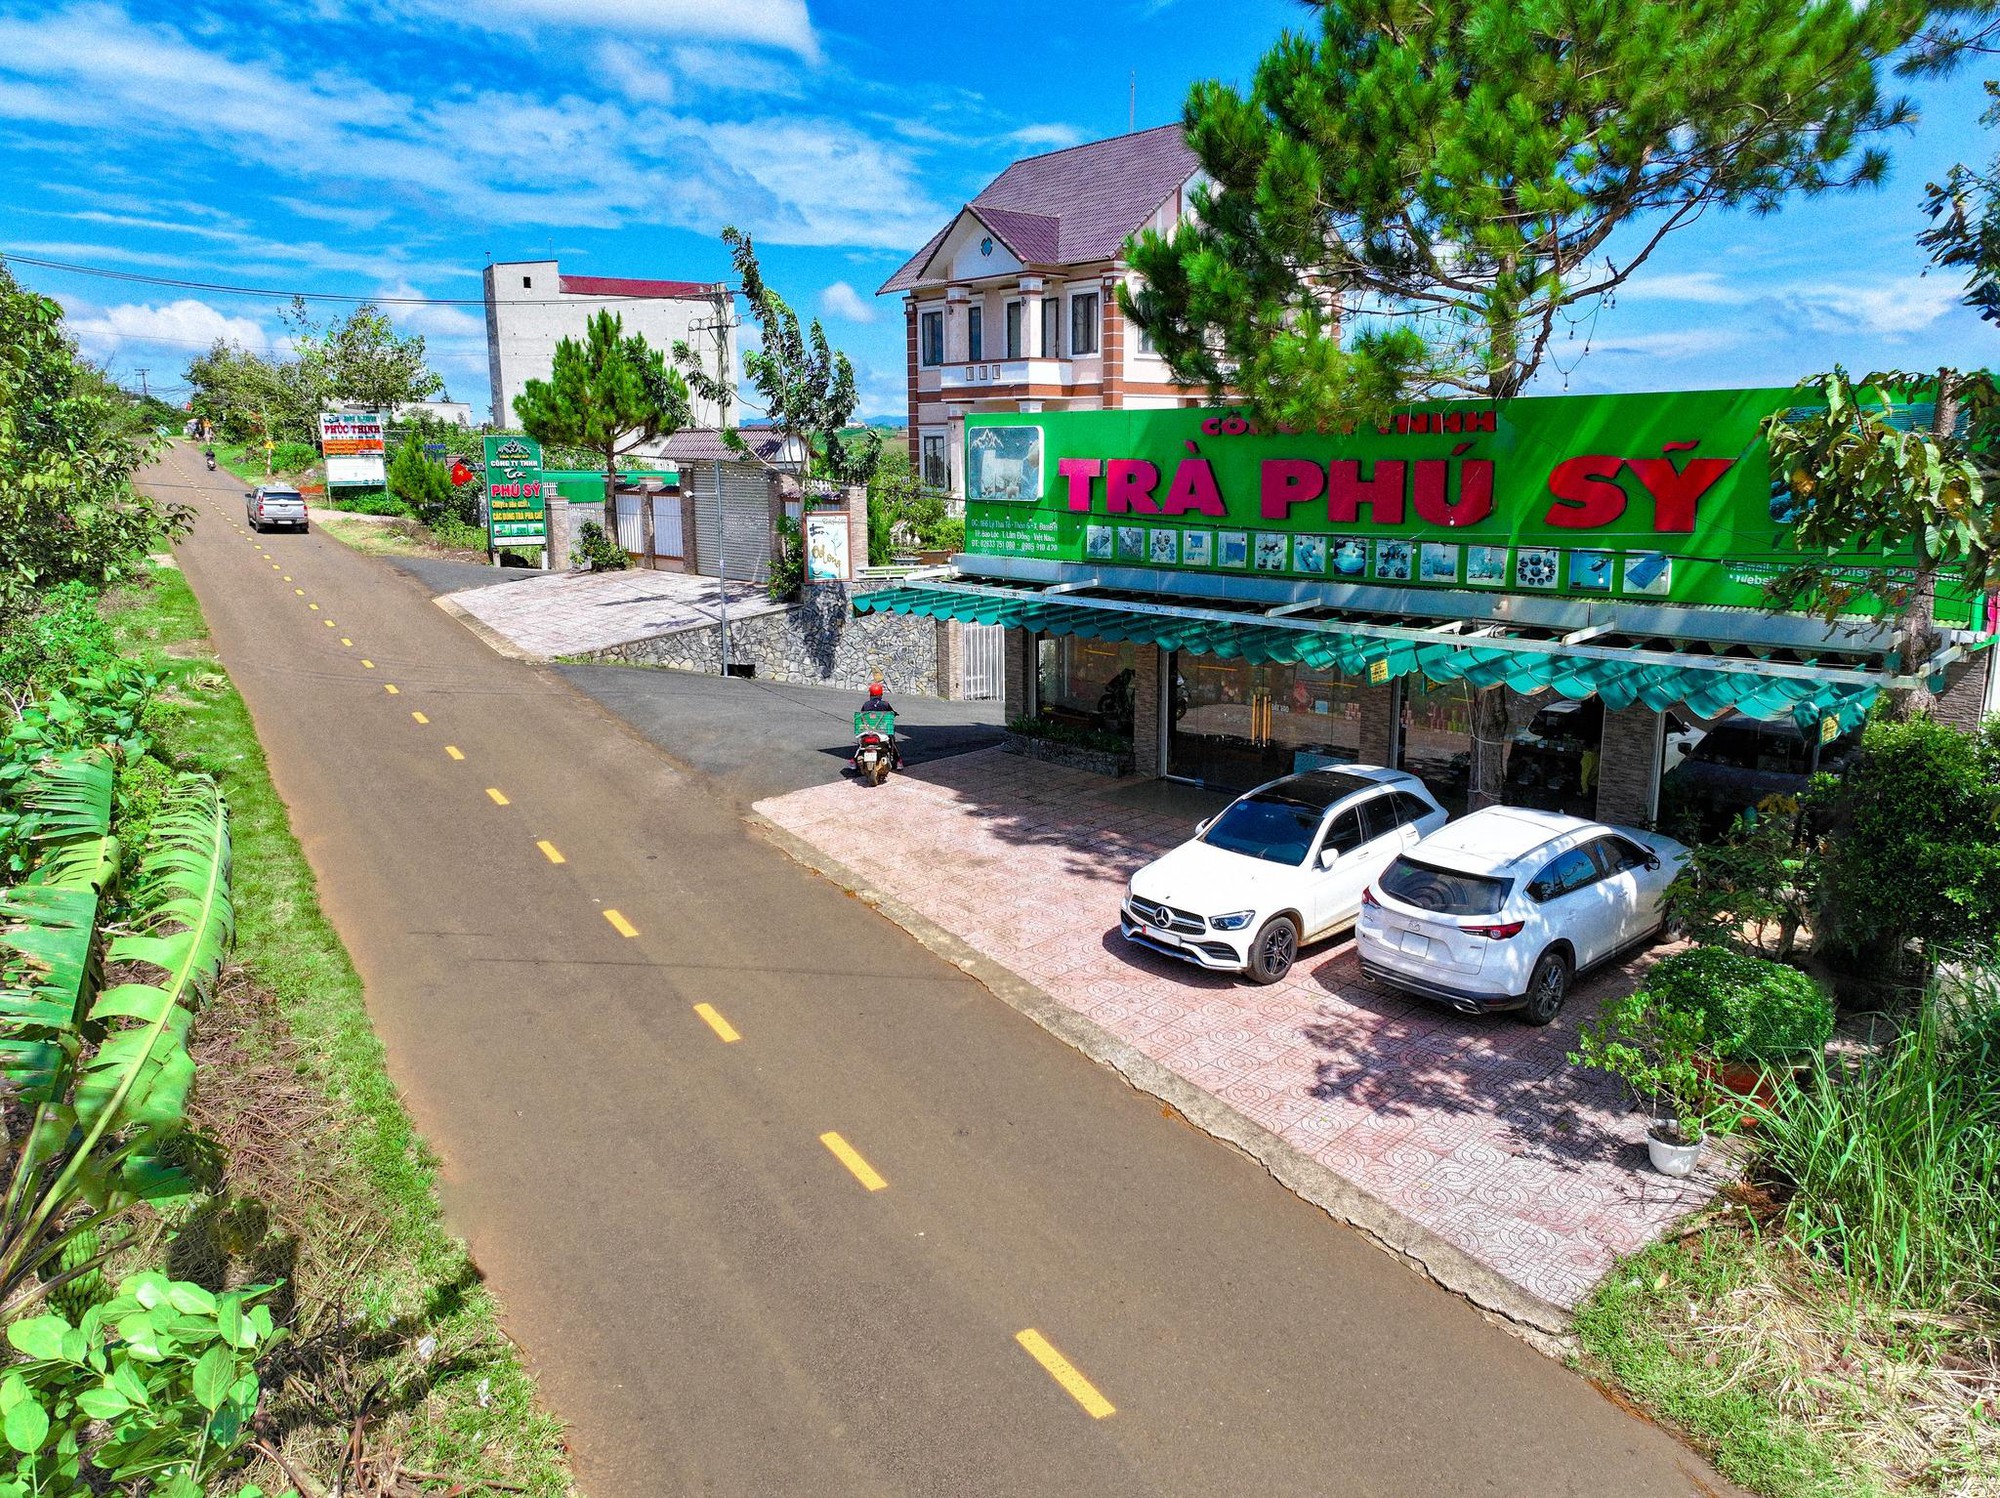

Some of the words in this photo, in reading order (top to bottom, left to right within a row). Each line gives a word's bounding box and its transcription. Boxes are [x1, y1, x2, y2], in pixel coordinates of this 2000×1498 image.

[1200, 409, 1304, 435] CÔ
[490, 459, 509, 467] CÔNG
[491, 480, 520, 497] PHÚ
[522, 480, 542, 498] SỸ
[1058, 439, 1229, 517] TRÀ
[1260, 442, 1496, 528] PHÚ
[1543, 440, 1738, 533] SỸ
